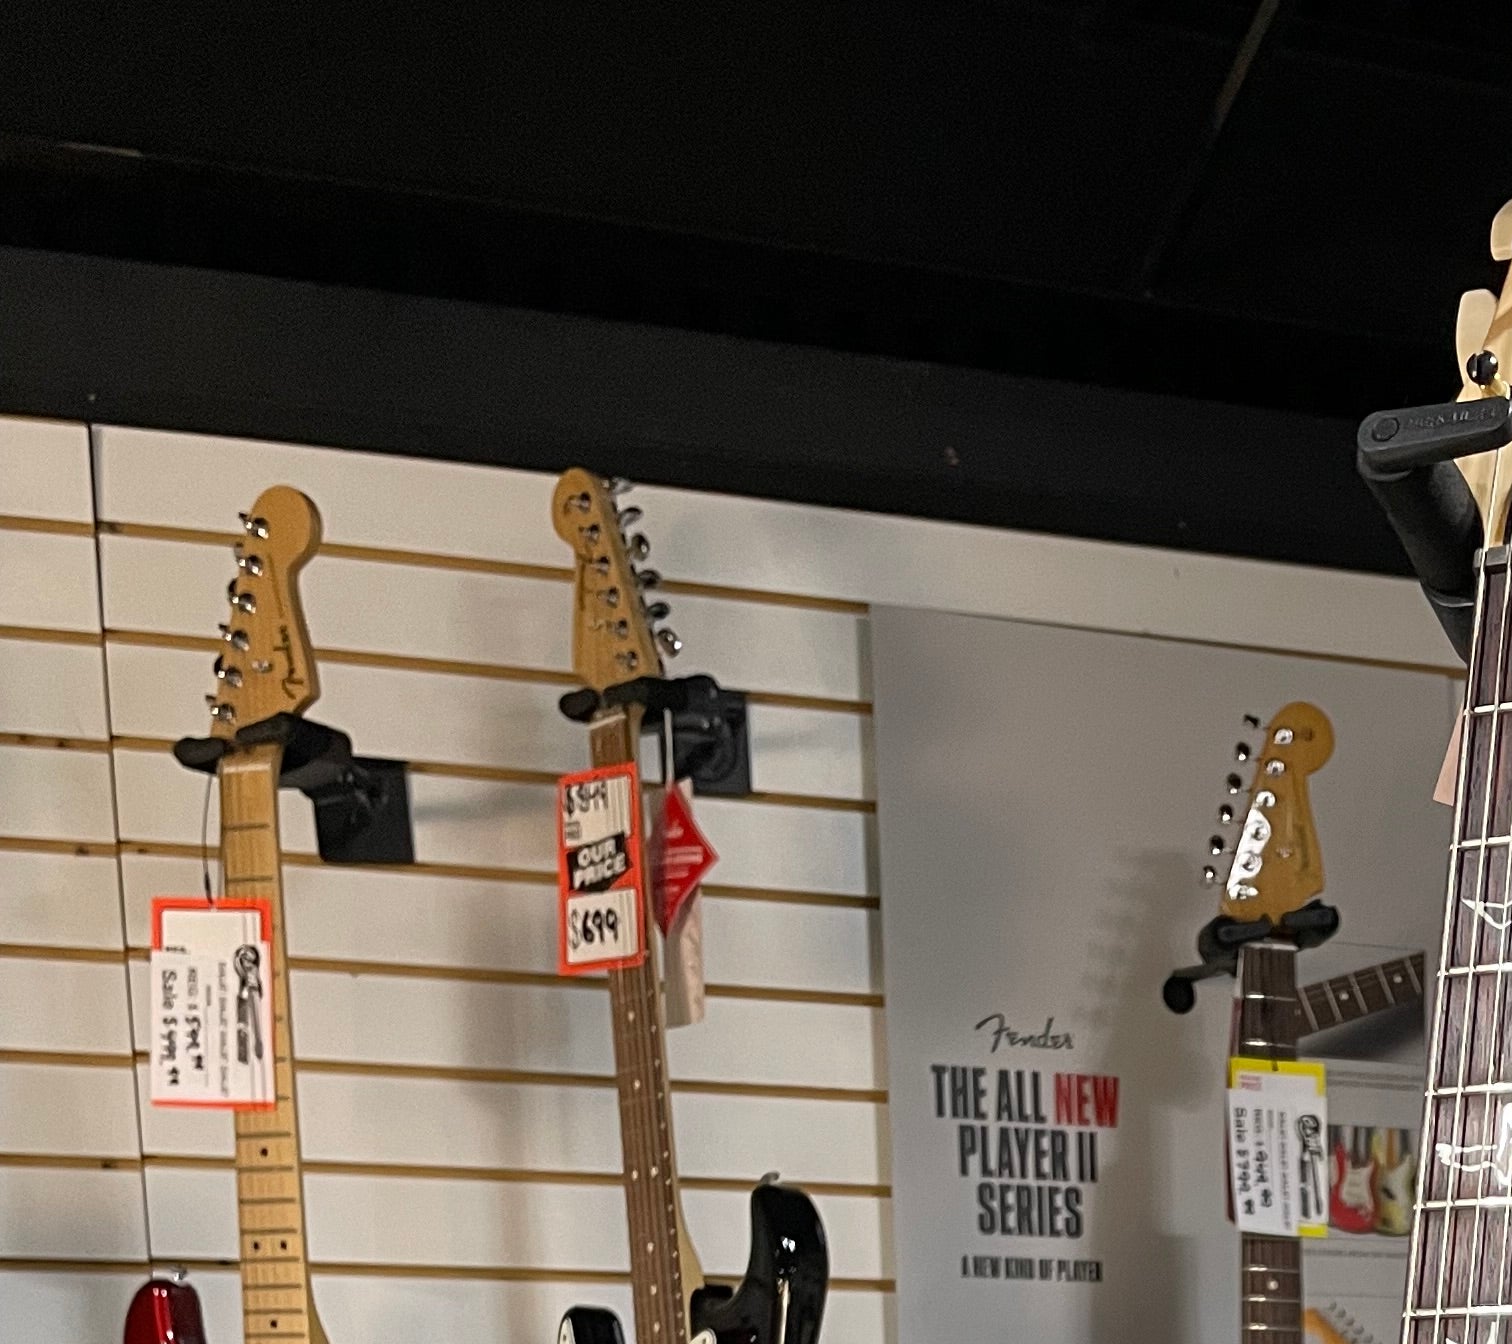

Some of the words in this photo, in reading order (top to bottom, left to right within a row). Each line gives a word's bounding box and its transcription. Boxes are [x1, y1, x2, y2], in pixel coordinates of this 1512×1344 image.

[570, 907, 619, 950] $699
[975, 1013, 1074, 1053] Fender
[930, 1064, 987, 1120] THE
[996, 1069, 1047, 1124] ALL
[1053, 1071, 1119, 1128] NEW
[1234, 1107, 1248, 1143] Sale
[958, 1124, 1070, 1182] PLAYER
[1077, 1131, 1098, 1183] II
[977, 1182, 1083, 1238] SERIES
